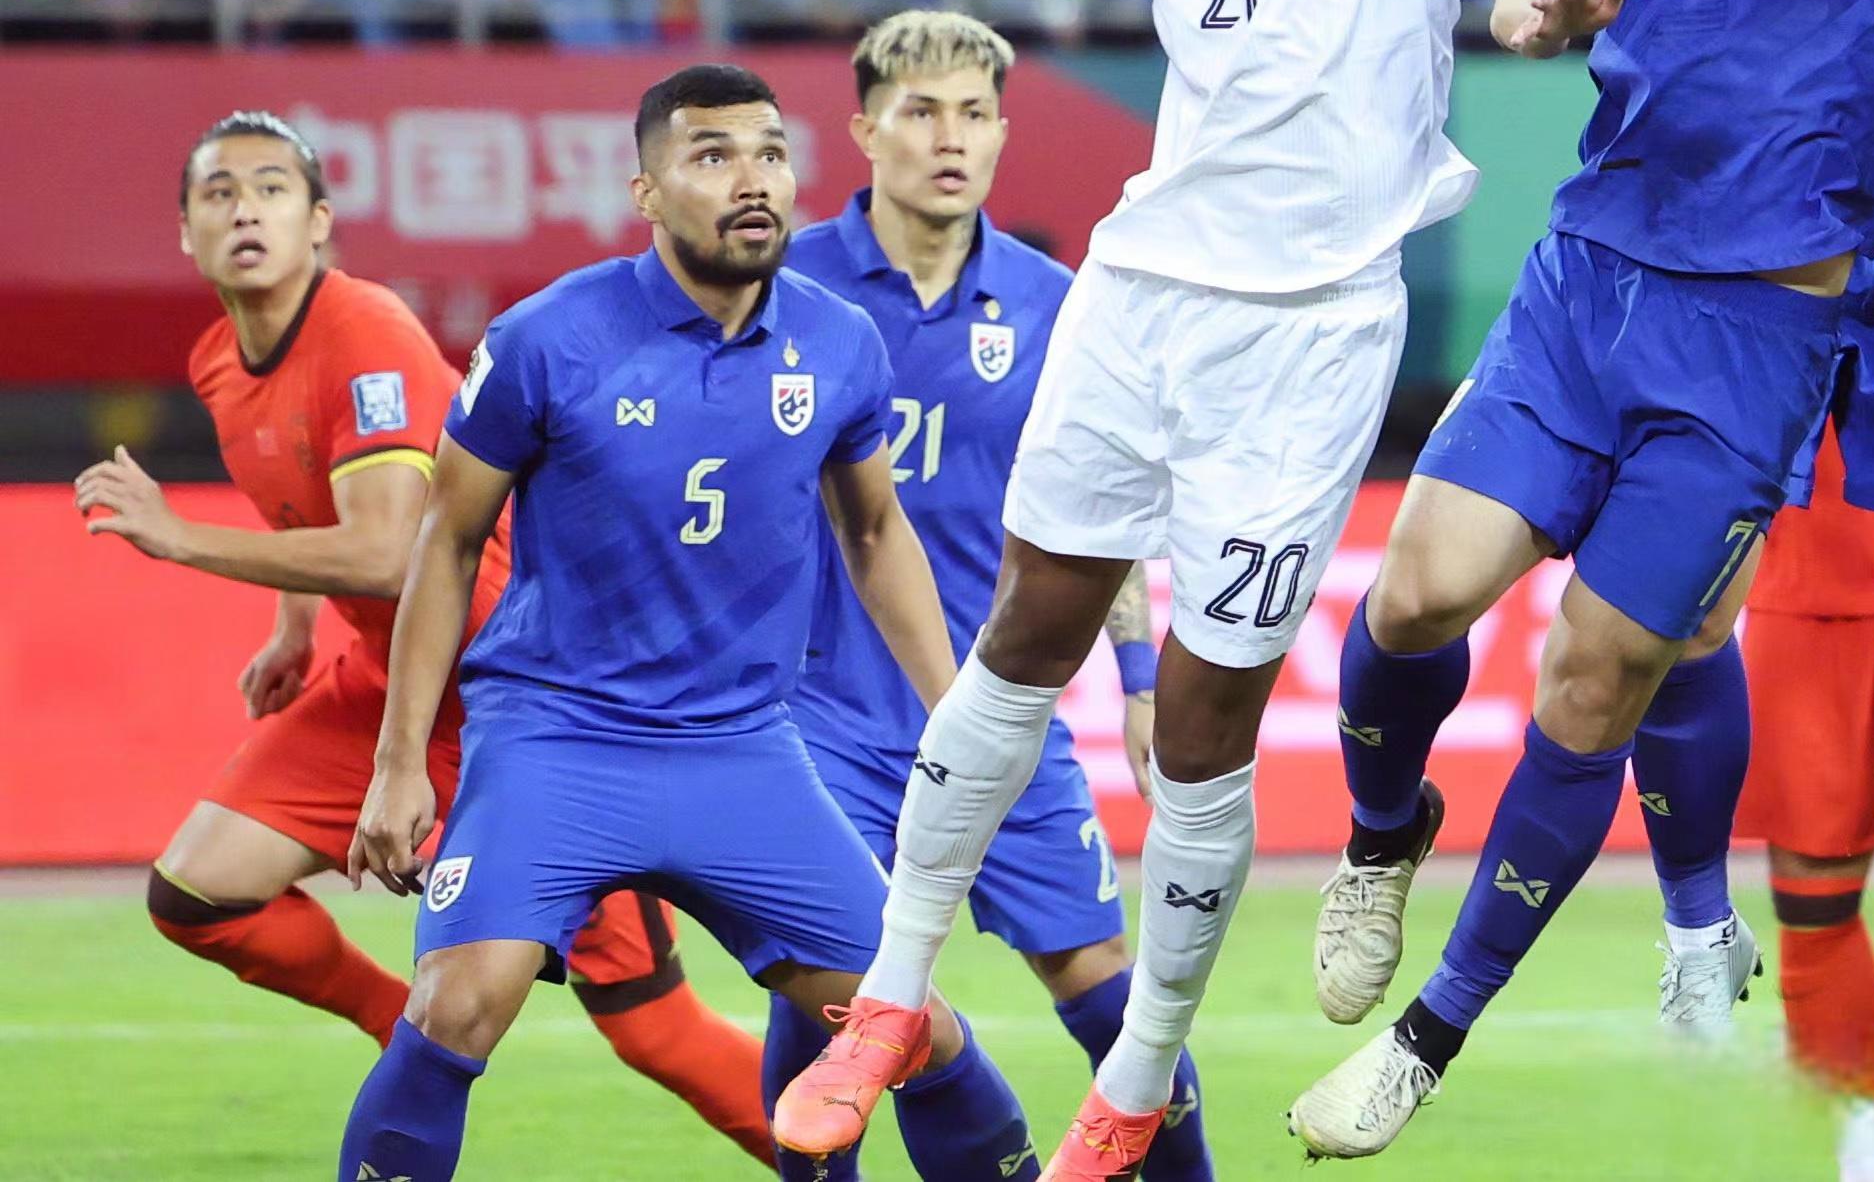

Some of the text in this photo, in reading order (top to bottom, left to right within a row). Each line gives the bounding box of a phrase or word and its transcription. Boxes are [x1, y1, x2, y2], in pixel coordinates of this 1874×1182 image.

[889, 397, 946, 484] 21
[679, 458, 727, 545] 5
[1204, 538, 1309, 628] 20
[1699, 520, 1758, 607] 7
